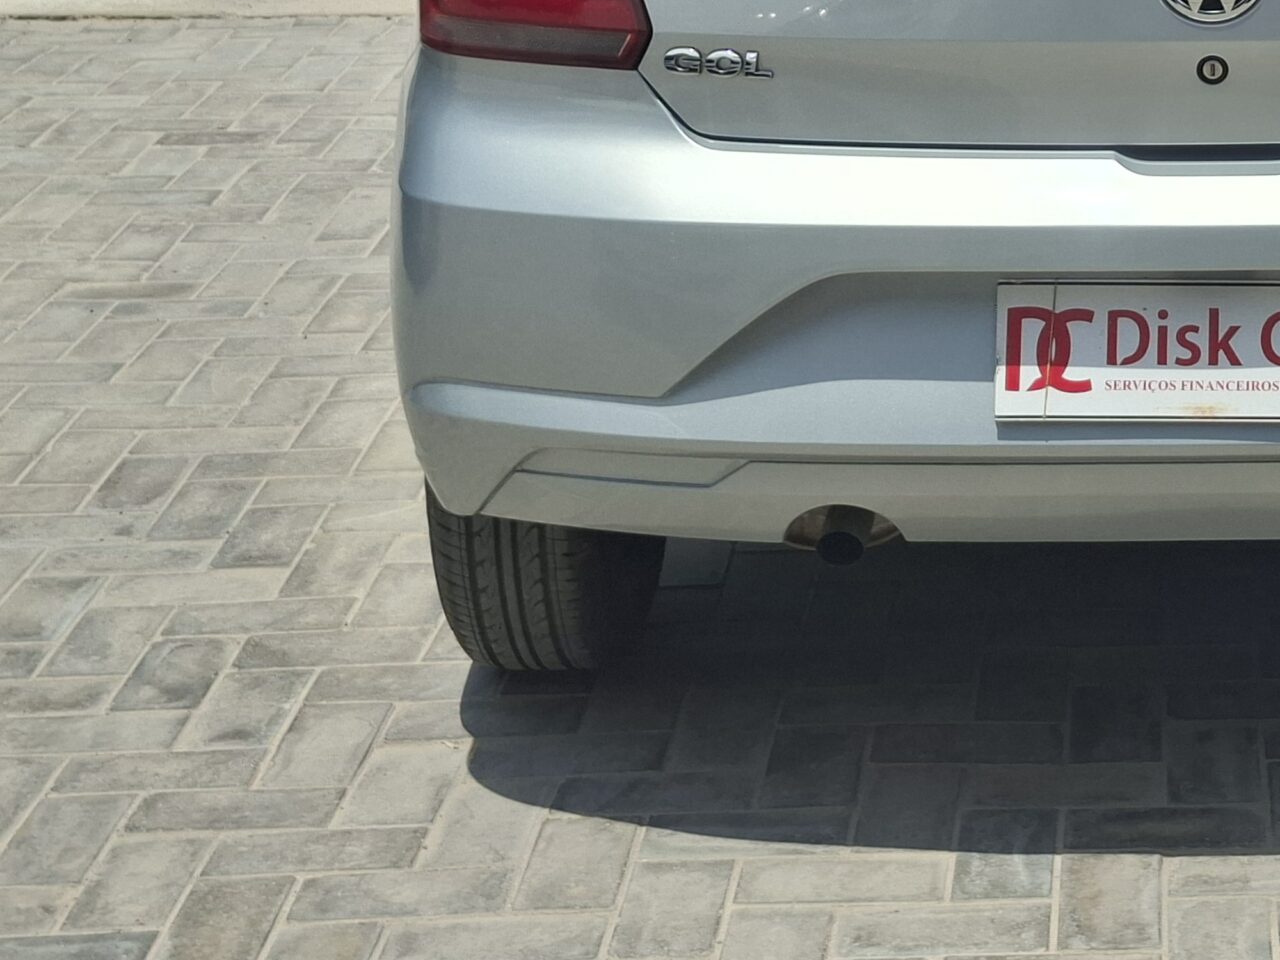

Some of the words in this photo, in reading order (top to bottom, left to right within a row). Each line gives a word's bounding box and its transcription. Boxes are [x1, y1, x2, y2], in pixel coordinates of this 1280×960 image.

[664, 46, 773, 78] GOL
[1106, 308, 1241, 367] Disk
[1104, 380, 1177, 393] SERVIÇOS
[1181, 380, 1280, 392] FINANCEIROS
